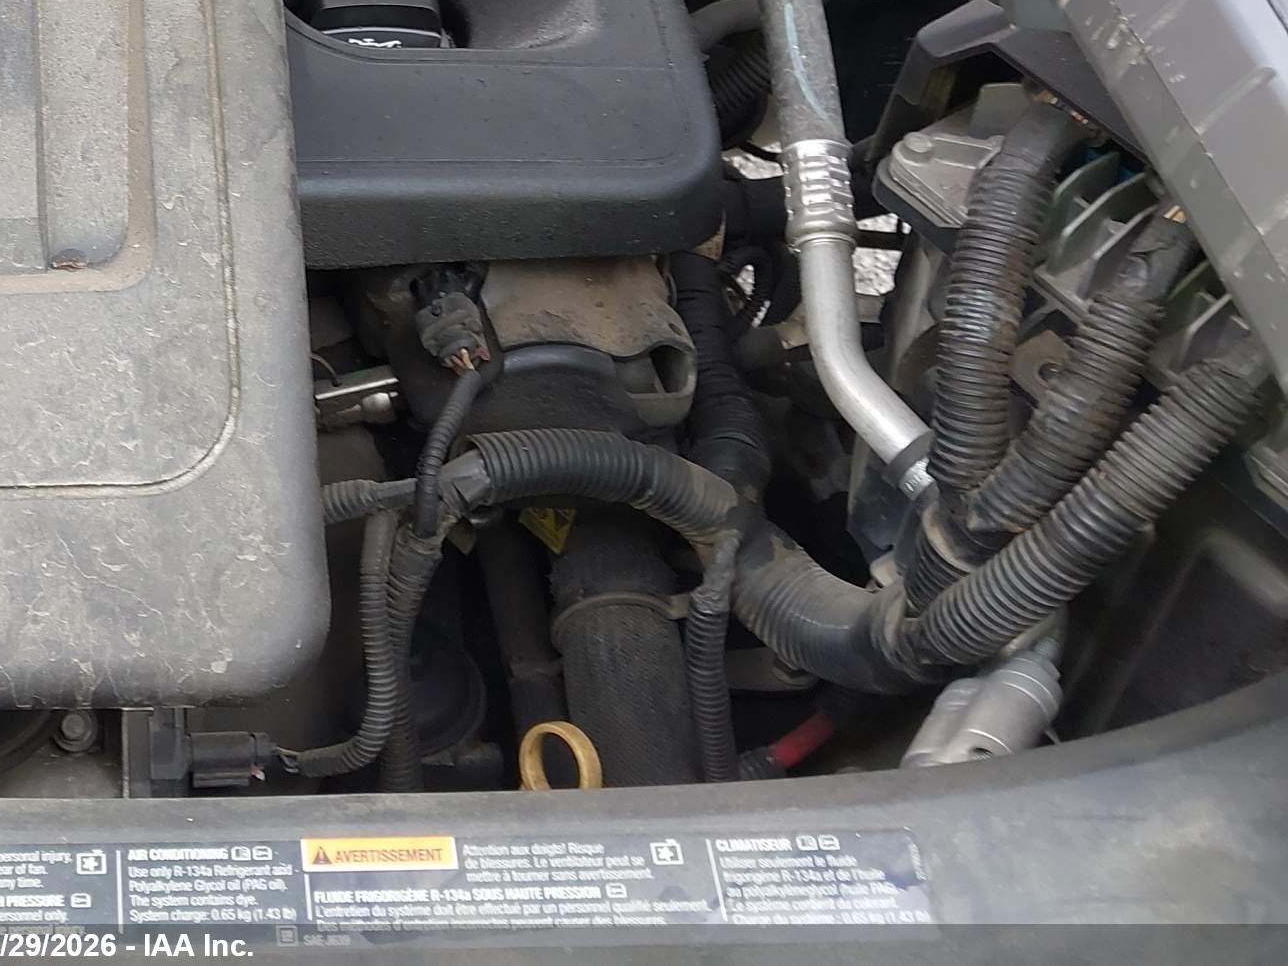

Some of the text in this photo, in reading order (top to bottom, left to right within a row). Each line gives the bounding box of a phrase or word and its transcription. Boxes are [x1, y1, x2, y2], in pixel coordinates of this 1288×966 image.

[463, 844, 509, 856] Attention
[510, 846, 530, 855] aux
[568, 842, 604, 855] Risque
[715, 838, 792, 851] CLIMATISEUR
[41, 852, 73, 864] injury.
[128, 848, 228, 860] AIR CONDITIONING
[334, 848, 443, 863] AVERTISSEMENT
[464, 857, 480, 869] de
[533, 856, 548, 868] Le
[549, 855, 603, 867] ventilateur
[605, 855, 630, 868] peut
[630, 856, 645, 866] se
[15, 864, 26, 875] of
[128, 866, 148, 878] Use
[150, 866, 172, 879] only
[173, 865, 212, 877] R-134a
[213, 864, 271, 878] Refrigerant
[466, 871, 501, 882] mettre
[551, 871, 577, 881] sans
[194, 879, 226, 893] Glycol
[227, 879, 241, 891] oil
[6, 895, 65, 907] PRESSURE
[129, 894, 259, 908] The system contains dye.
[314, 890, 353, 903] FLUIDE
[472, 888, 504, 901] SOUS
[504, 887, 544, 900] HAUTE
[544, 886, 601, 899] PRESSION
[44, 910, 69, 923] only.
[129, 909, 169, 923] System
[237, 908, 252, 922] kg
[372, 905, 386, 916] du
